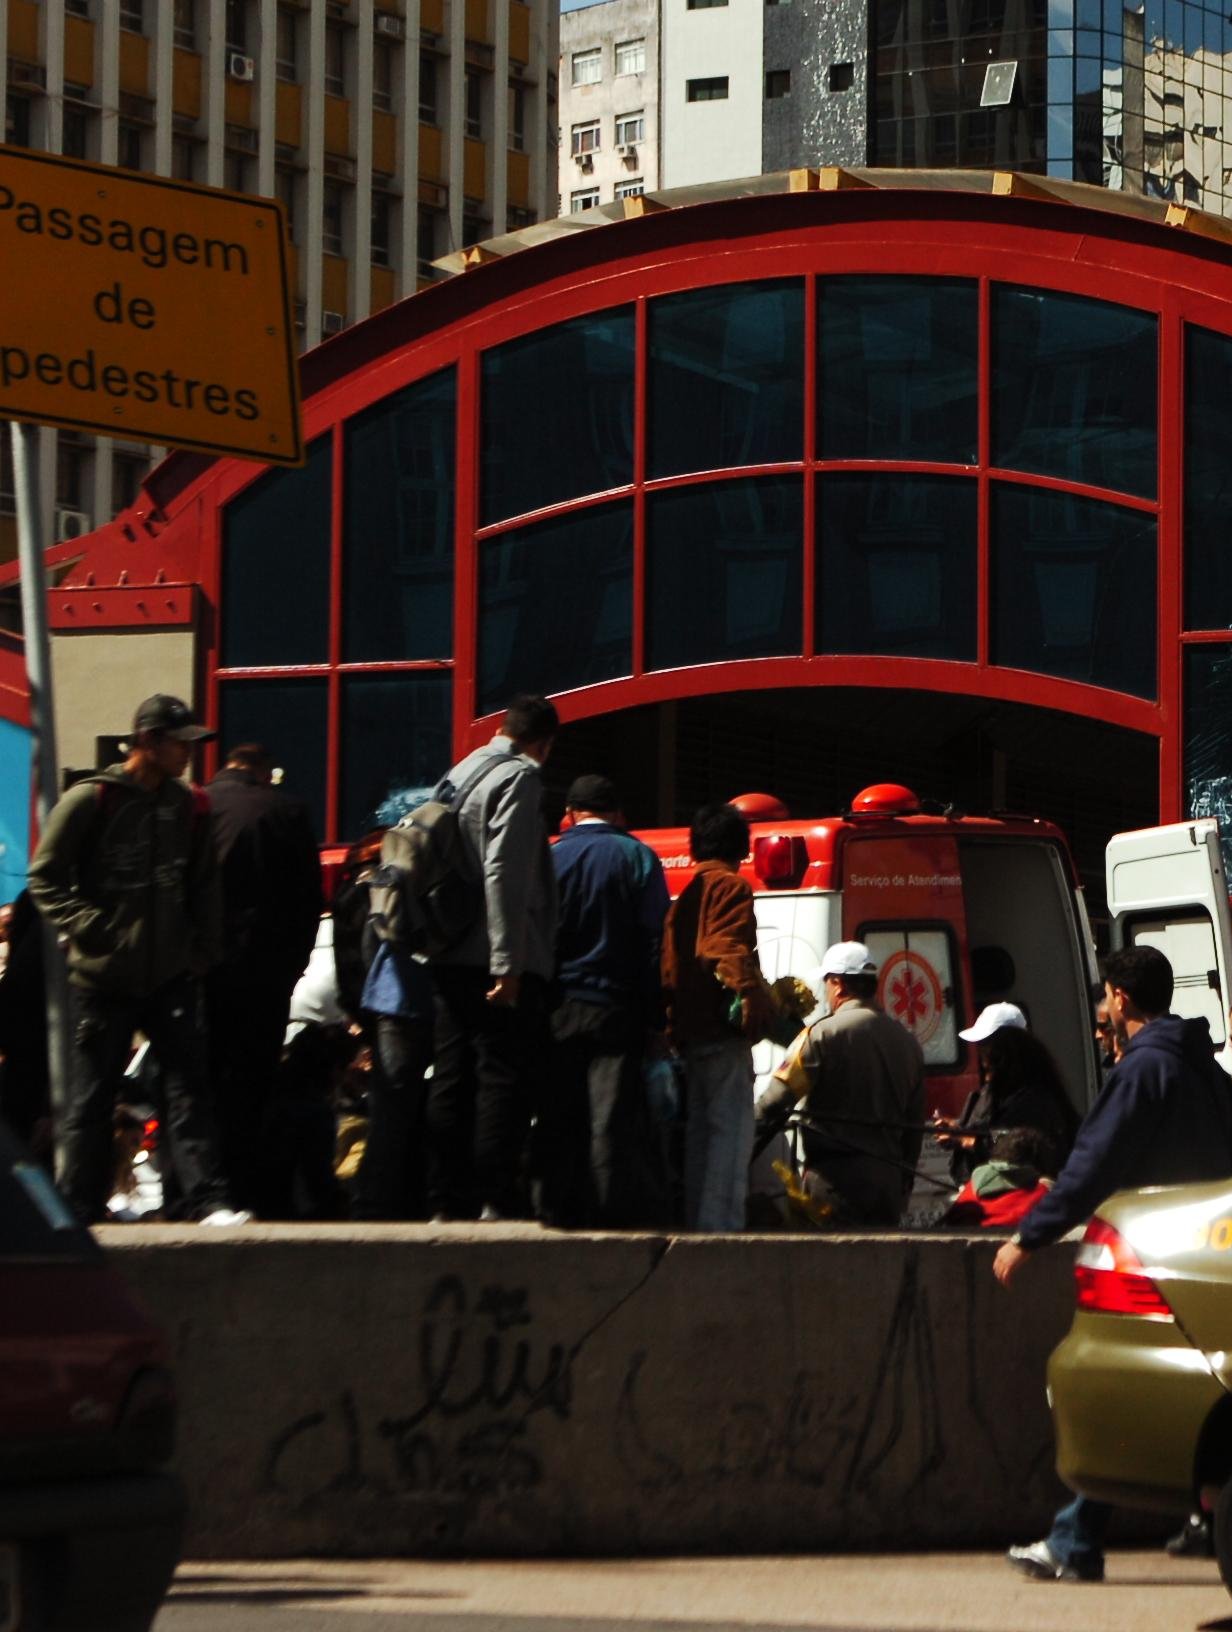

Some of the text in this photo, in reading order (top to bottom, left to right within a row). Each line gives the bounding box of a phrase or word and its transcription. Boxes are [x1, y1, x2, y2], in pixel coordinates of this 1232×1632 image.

[94, 281, 156, 329] de
[2, 347, 260, 421] pedestres
[892, 875, 905, 886] de
